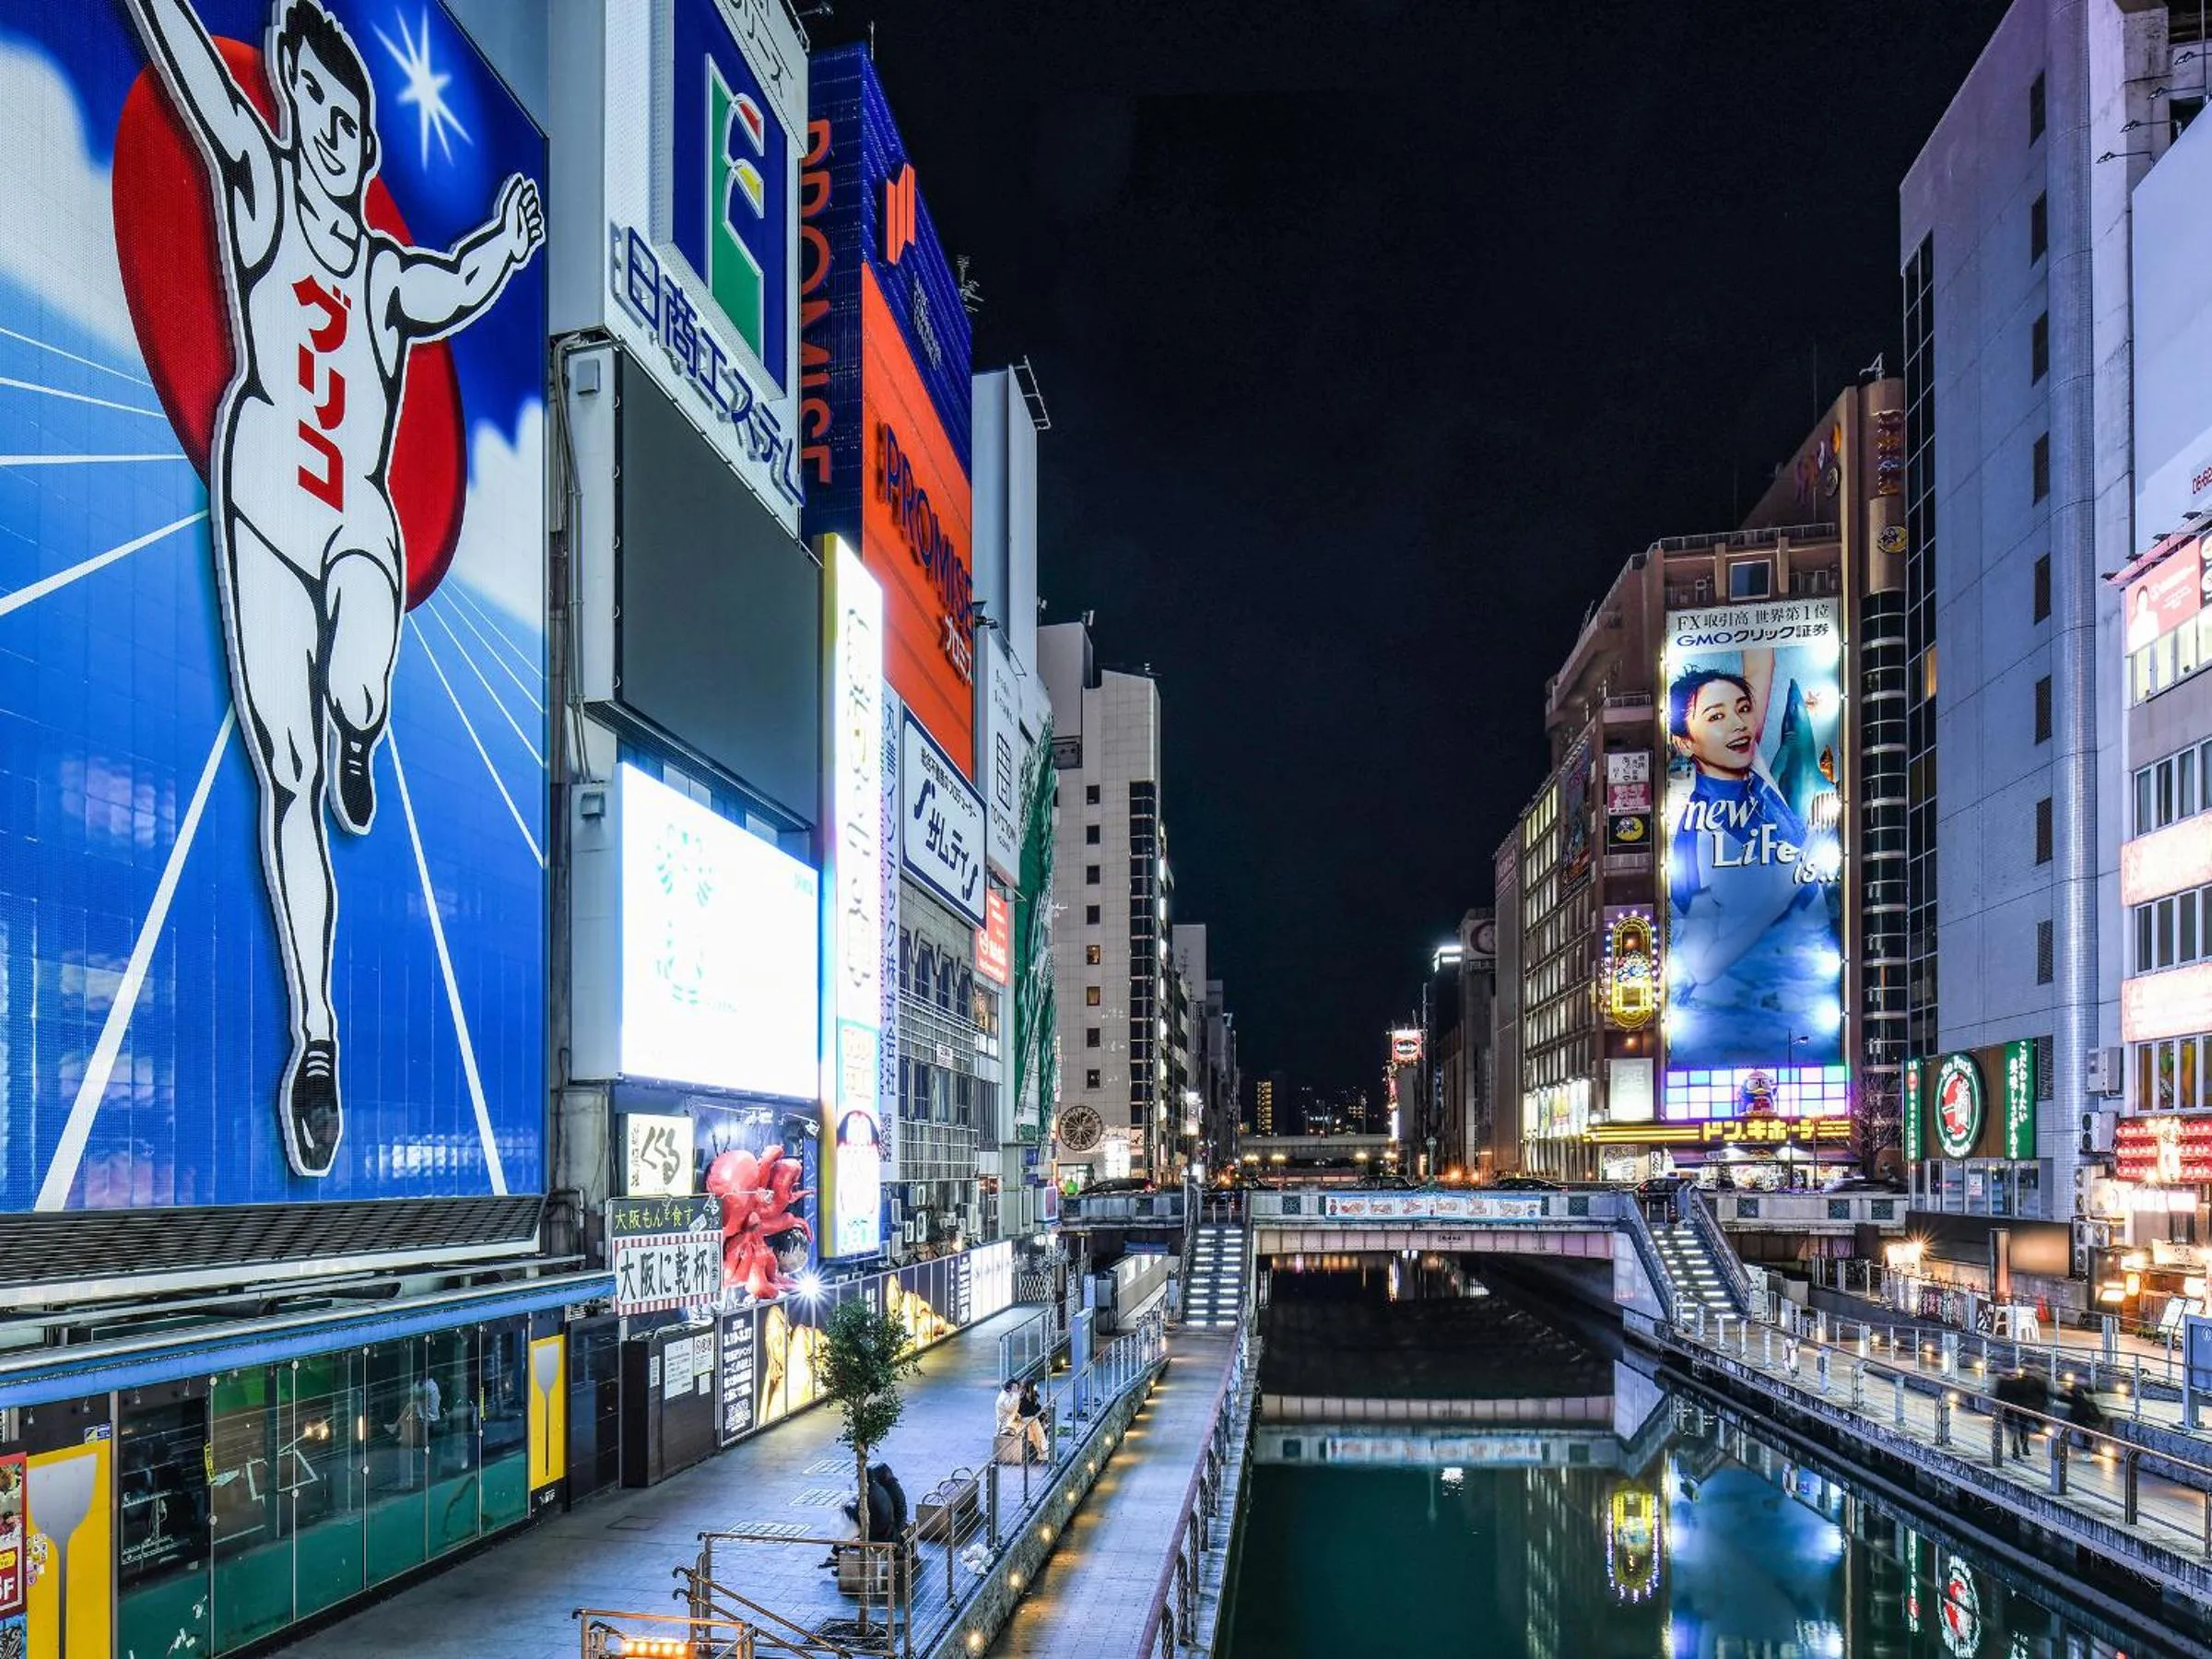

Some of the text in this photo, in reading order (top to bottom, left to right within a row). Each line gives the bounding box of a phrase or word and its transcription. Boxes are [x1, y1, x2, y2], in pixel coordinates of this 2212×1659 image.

[1677, 615, 1701, 631] FX
[1705, 610, 1748, 629] 取引高
[1677, 623, 1830, 647] GMOクリック証券
[619, 1244, 709, 1301] 大阪に乾杯
